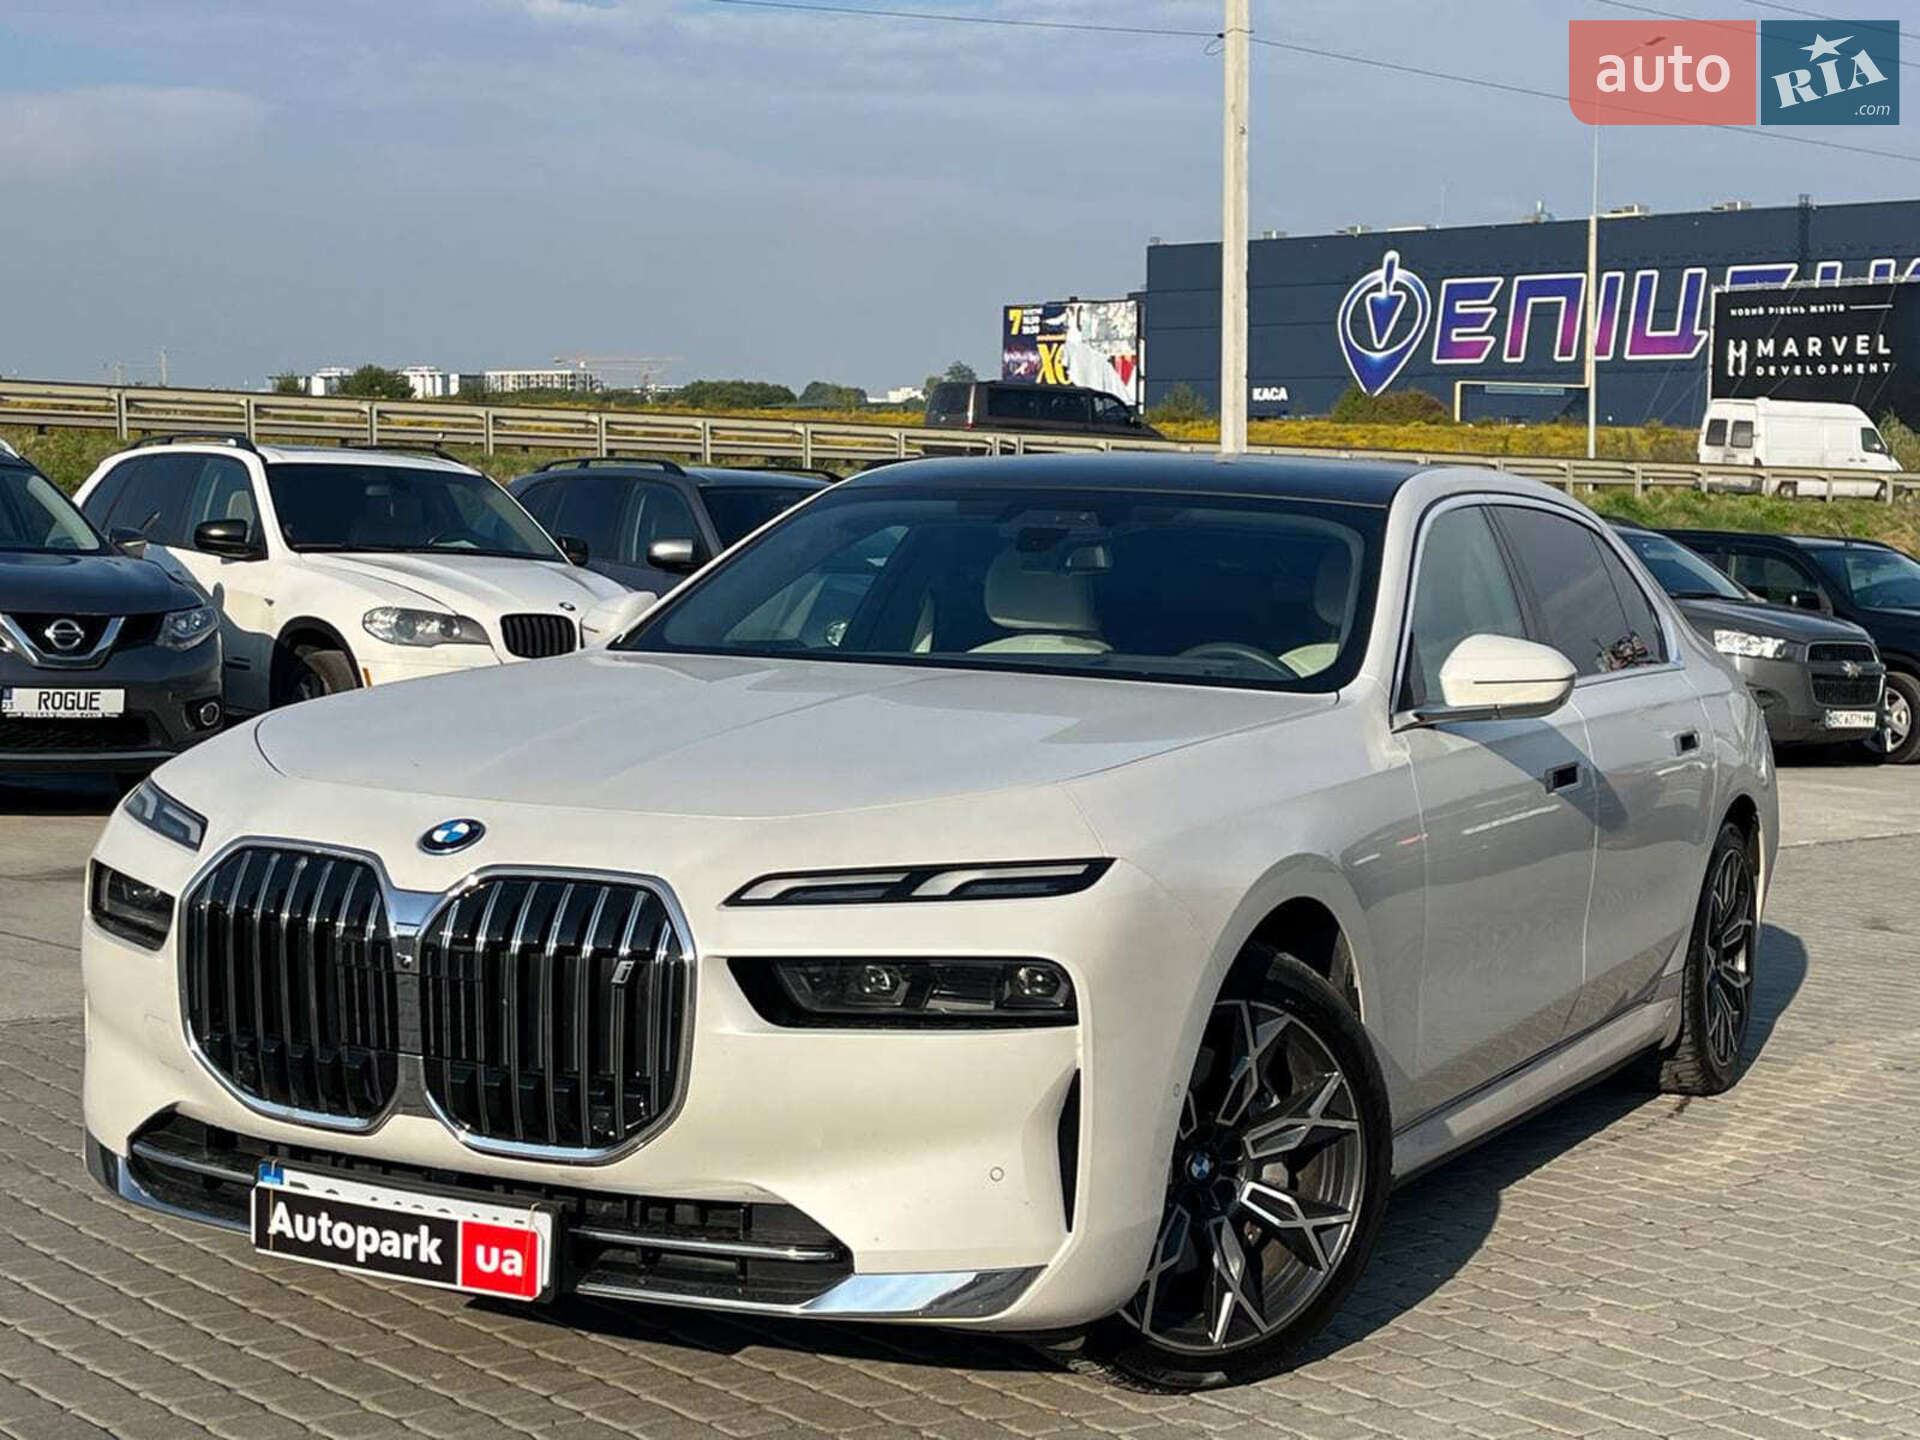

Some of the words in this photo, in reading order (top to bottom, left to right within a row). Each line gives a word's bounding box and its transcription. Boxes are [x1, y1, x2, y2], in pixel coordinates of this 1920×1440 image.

[1008, 308, 1022, 336] 7
[1757, 334, 1892, 358] MARVEL
[1756, 362, 1891, 376] DEVELOPMENT
[1252, 387, 1288, 401] КАСА
[38, 691, 101, 711] ROGUE
[267, 1201, 443, 1265] Autopark
[475, 1244, 523, 1277] ua
